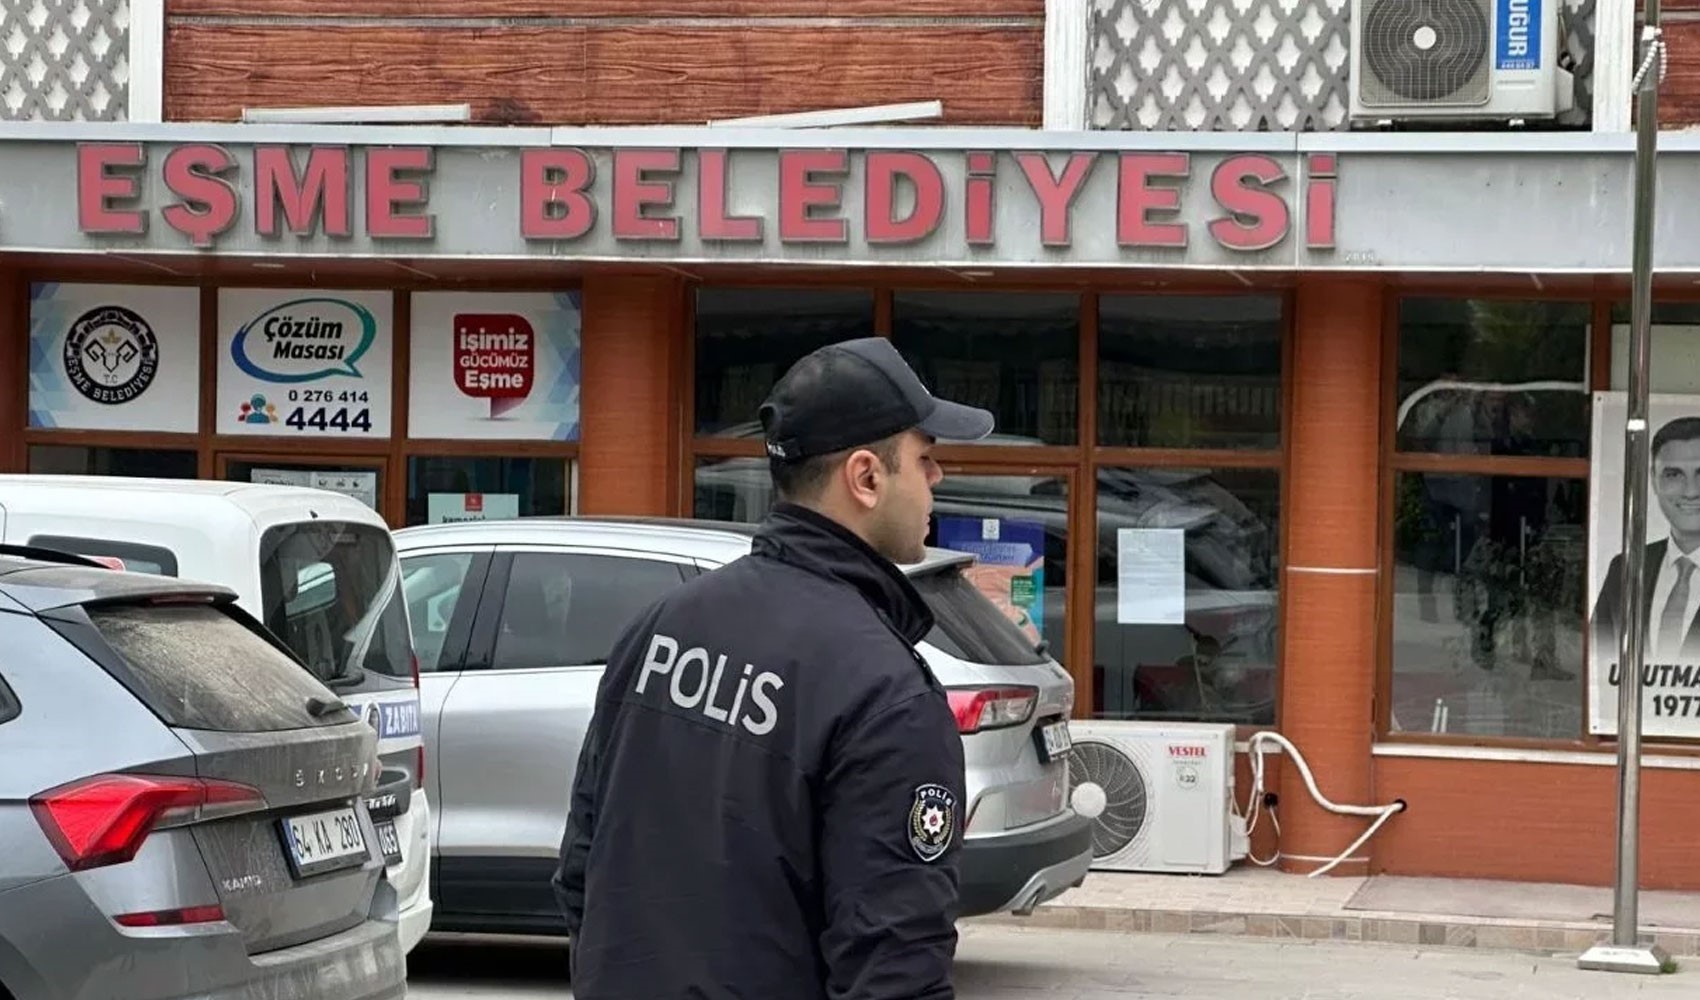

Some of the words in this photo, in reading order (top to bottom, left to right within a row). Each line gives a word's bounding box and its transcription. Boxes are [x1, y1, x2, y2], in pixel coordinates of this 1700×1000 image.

[76, 141, 436, 247] EŞME
[264, 316, 342, 343] Çözüm
[273, 341, 345, 360] Masası
[460, 352, 528, 368] GÜCÜMÜZ
[465, 370, 524, 390] Eşme
[288, 390, 298, 401] 0
[304, 390, 333, 402] 276
[338, 391, 369, 403] 414
[286, 407, 372, 432] 4444
[1608, 663, 1700, 687] UUTM
[1168, 746, 1206, 757] VESTEL
[292, 824, 312, 858] 64
[312, 819, 334, 855] KA
[334, 814, 360, 850] 280
